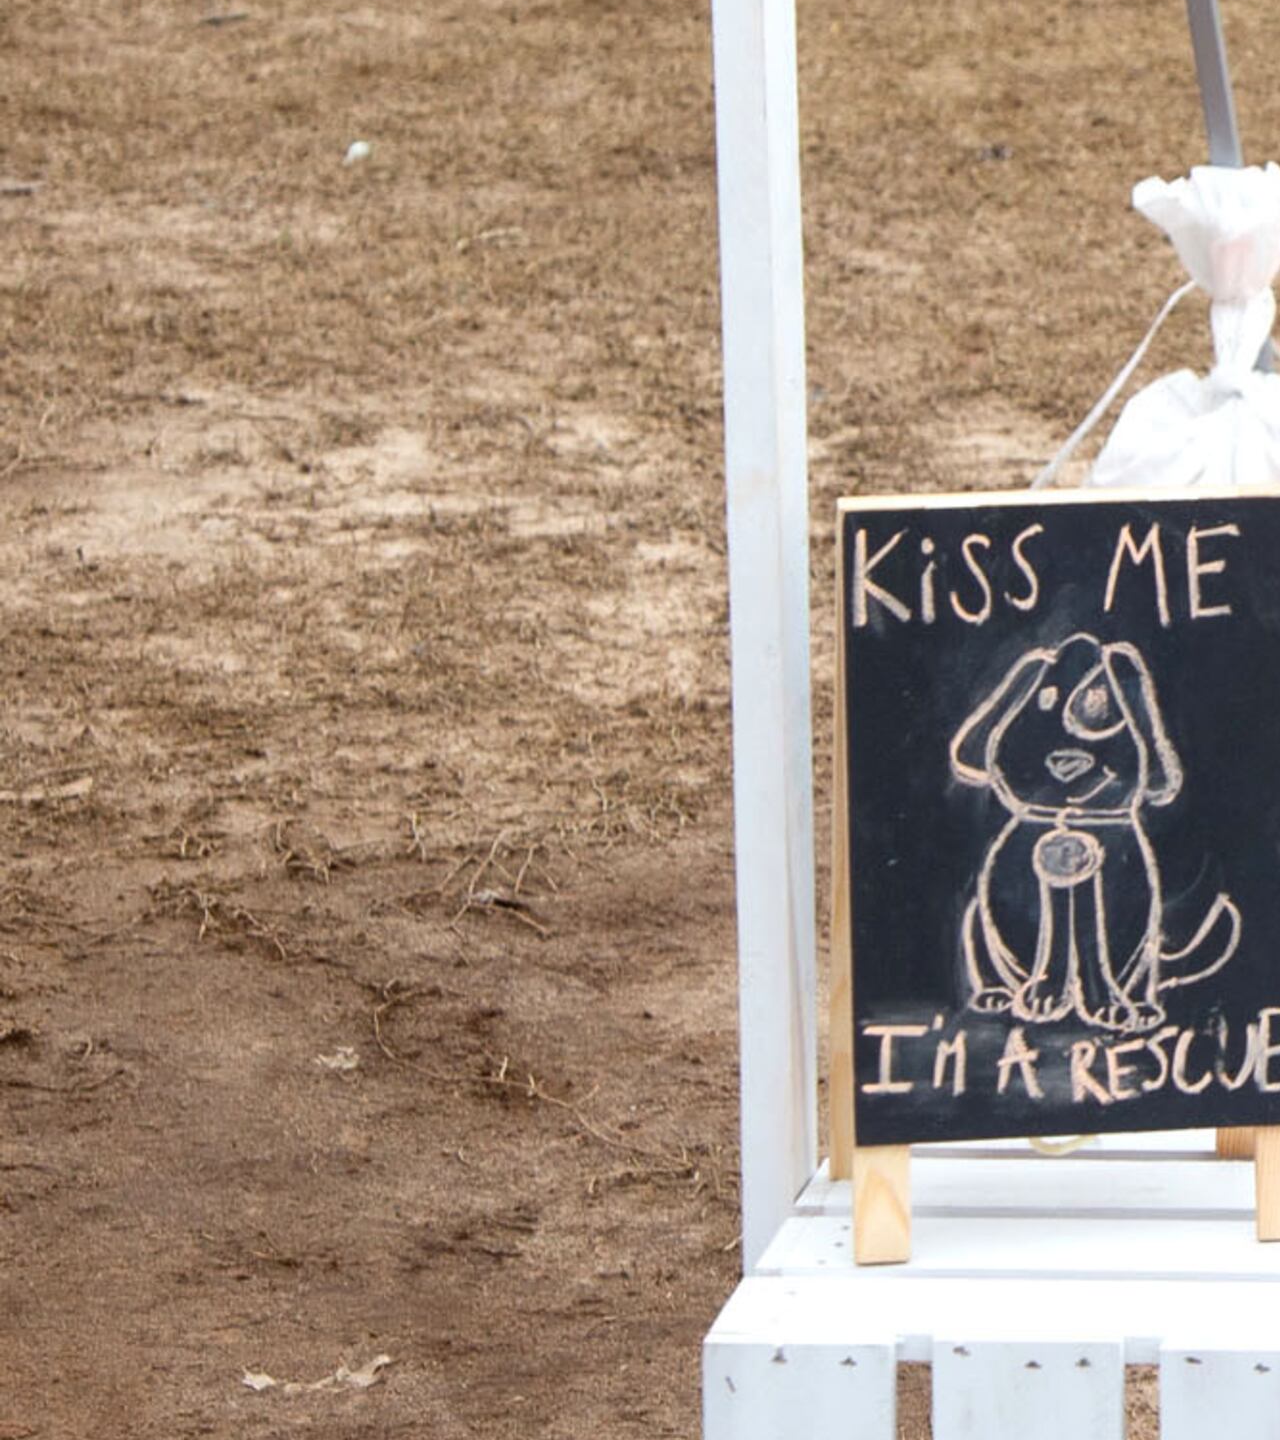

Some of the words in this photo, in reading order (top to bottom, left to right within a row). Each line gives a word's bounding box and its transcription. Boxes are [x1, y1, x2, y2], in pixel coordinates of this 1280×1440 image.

[1103, 522, 1240, 628] ME
[861, 1016, 967, 1096] I'M
[997, 1024, 1045, 1100] A
